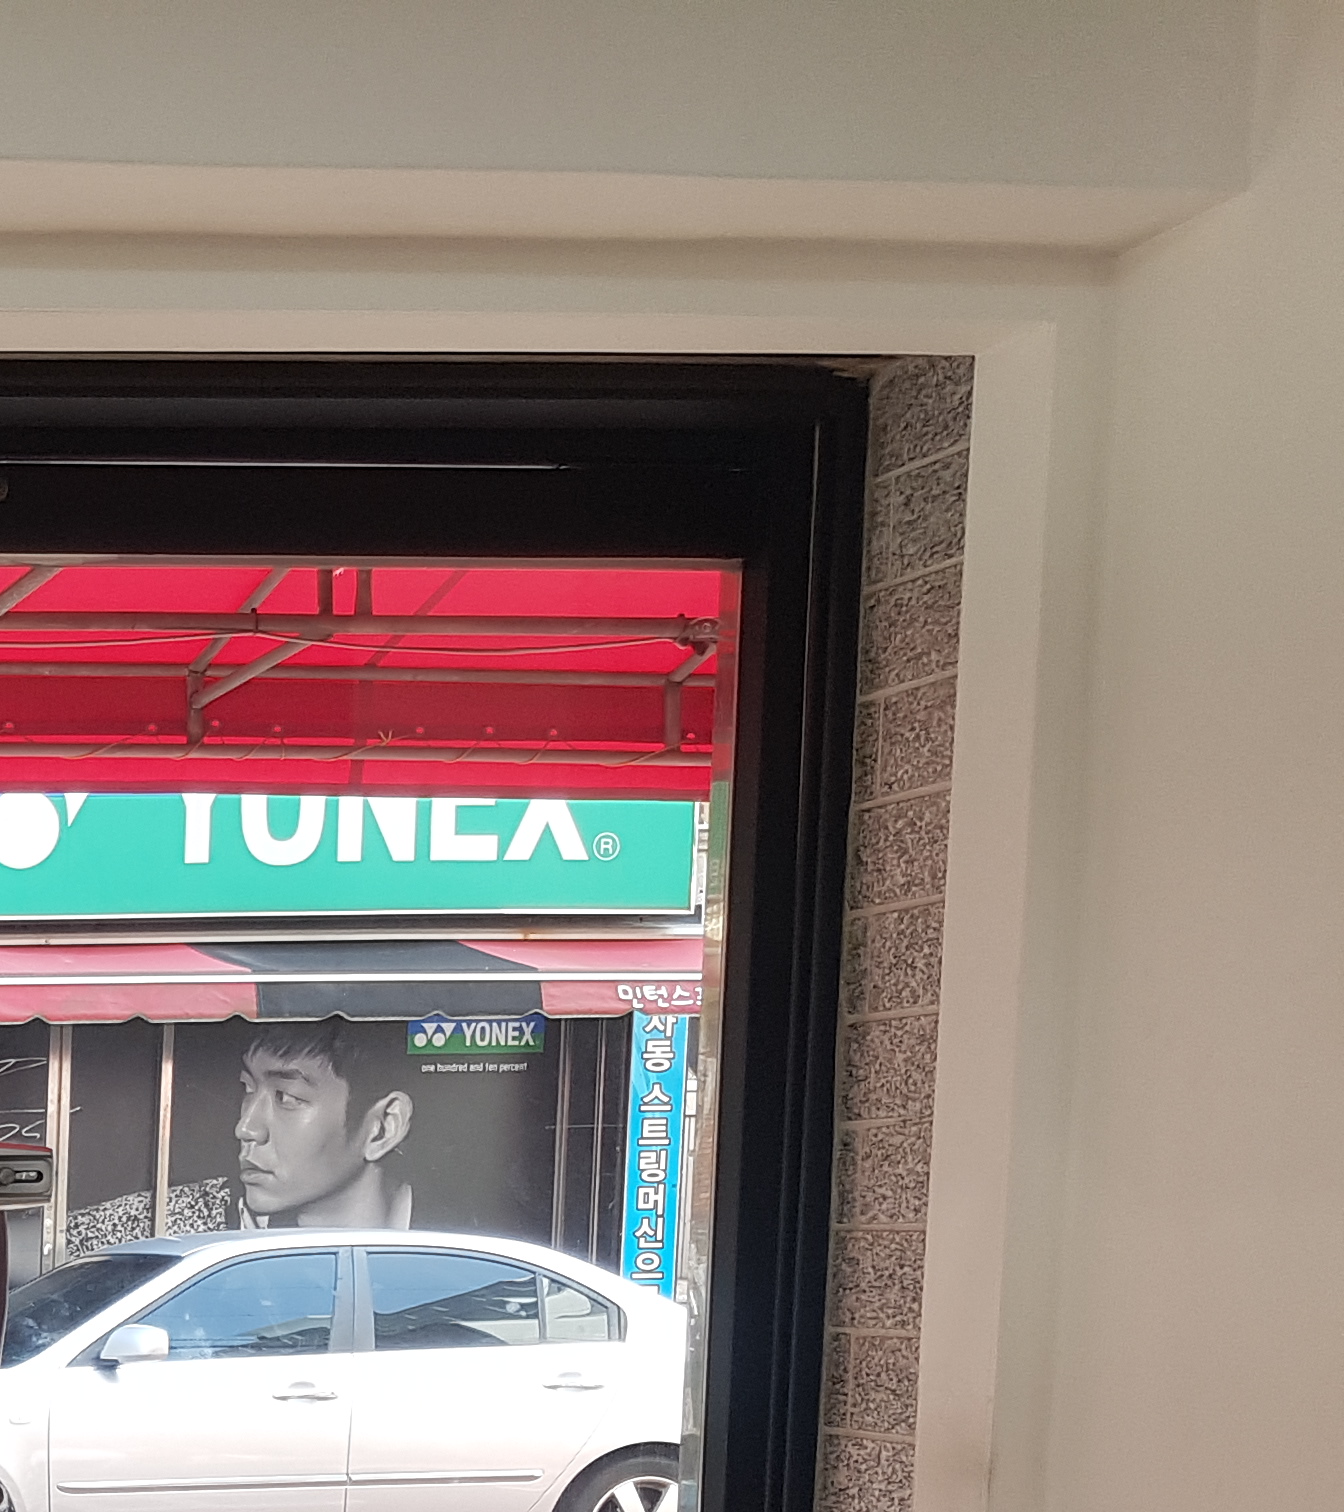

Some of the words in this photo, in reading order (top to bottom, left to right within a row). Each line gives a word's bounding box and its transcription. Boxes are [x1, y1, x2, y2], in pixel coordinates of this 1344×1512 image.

[616, 984, 703, 1009] 민턴스
[461, 1021, 536, 1047] YONEX
[630, 1082, 673, 1295] 스트링머신으
